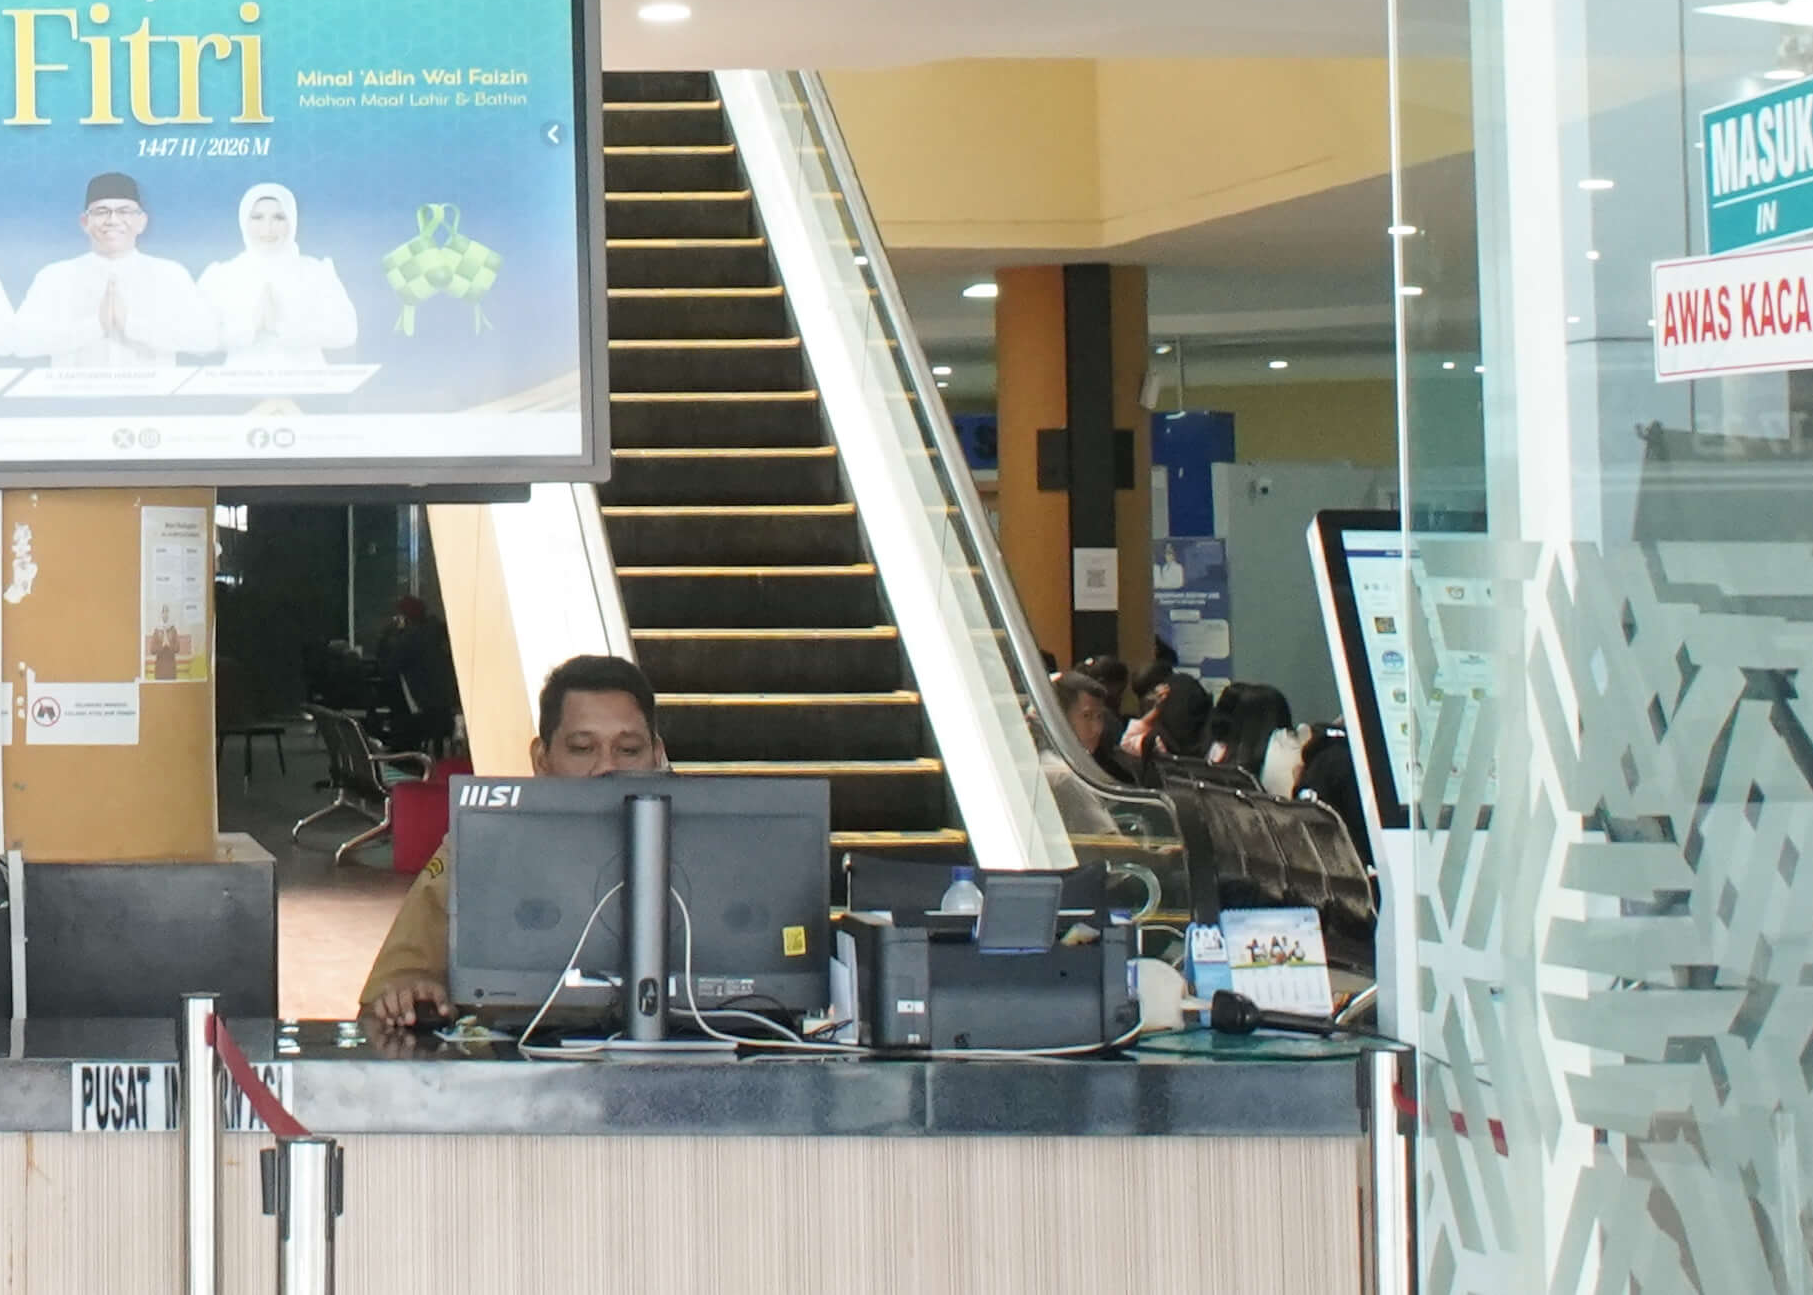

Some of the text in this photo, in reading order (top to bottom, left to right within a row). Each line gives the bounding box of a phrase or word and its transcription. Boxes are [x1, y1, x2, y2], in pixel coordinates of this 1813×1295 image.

[1, 1, 275, 127] Fitri
[296, 69, 354, 87] Minal
[422, 68, 463, 87] Wal
[468, 67, 529, 87] Faizin
[298, 93, 356, 107] Mohon
[361, 93, 405, 107] Maaf
[409, 93, 450, 107] Lahir
[474, 93, 528, 107] Bathin
[136, 137, 179, 157] 1447
[206, 137, 250, 156] 2026
[251, 137, 271, 156] M
[1709, 94, 1813, 198] MASUK
[1755, 200, 1779, 235] IN
[1663, 276, 1813, 347] AWAS KACA
[80, 1065, 151, 1131] PUSAT
